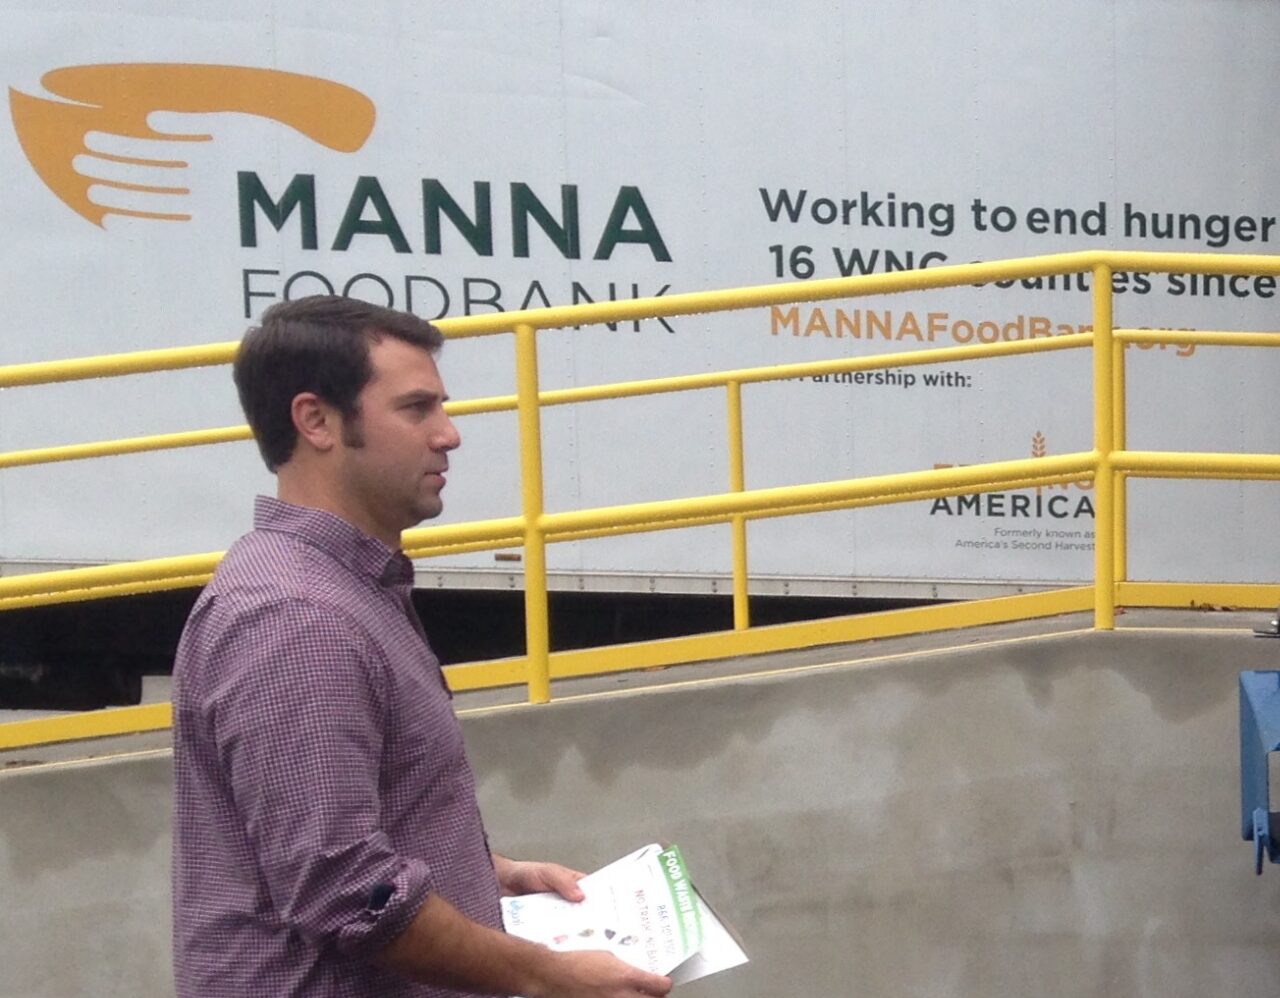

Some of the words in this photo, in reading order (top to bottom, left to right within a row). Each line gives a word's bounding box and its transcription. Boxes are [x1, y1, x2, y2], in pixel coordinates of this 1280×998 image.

[237, 171, 673, 262] MANNA
[759, 187, 955, 237] Working
[971, 198, 1017, 233] to
[1026, 201, 1107, 236] end
[1124, 202, 1276, 248] hunger
[769, 244, 815, 280] 16
[1167, 271, 1277, 300] since
[799, 369, 916, 389] artnership
[923, 370, 973, 388] with:
[930, 494, 1096, 520] AMERICA
[955, 539, 1009, 550] America's
[1011, 540, 1052, 551] Second
[994, 528, 1042, 539] Formerly
[1045, 529, 1082, 539] known
[662, 849, 683, 881] FOOD
